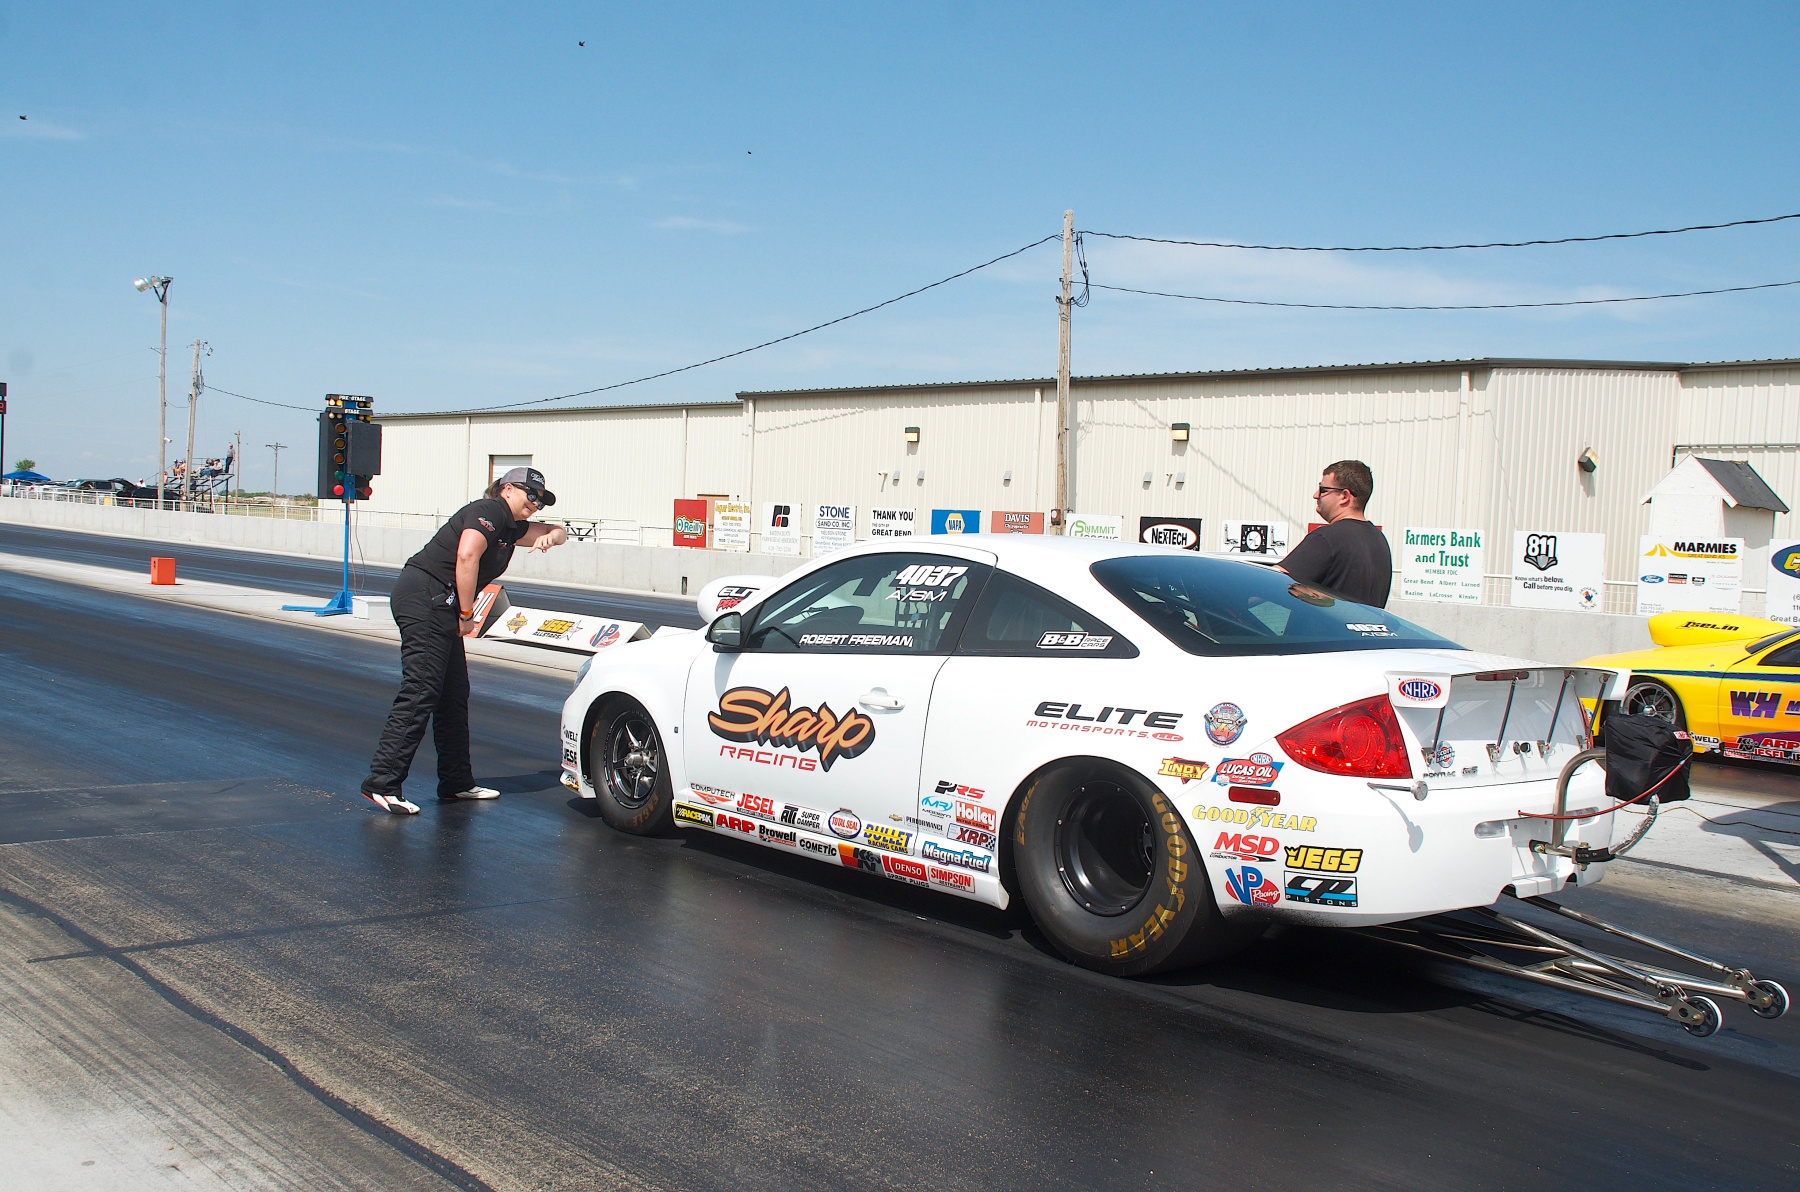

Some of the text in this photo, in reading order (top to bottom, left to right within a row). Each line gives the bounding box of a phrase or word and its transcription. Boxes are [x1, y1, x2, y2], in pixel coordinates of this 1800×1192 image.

[820, 506, 850, 518] STONE
[872, 510, 914, 521] THANK YOU
[1004, 514, 1030, 523] DAVIS
[676, 517, 704, 535] O'Reilly
[818, 520, 831, 528] SAND
[948, 520, 962, 530] NAPA
[1075, 520, 1116, 534] SUMMIT
[1406, 530, 1481, 548] Farmers Bank
[1527, 534, 1557, 558] 811
[1674, 542, 1737, 554] MARMIES
[1415, 550, 1470, 567] and Trust
[896, 565, 969, 586] 4037
[885, 588, 946, 602] A/SM
[1770, 614, 1791, 622] Great
[540, 619, 575, 633] JEGS
[591, 624, 619, 647] VP
[799, 634, 849, 645] ROBERT
[1041, 634, 1084, 645] B&B
[1405, 682, 1435, 697] NHRA
[1034, 701, 1184, 730] ELITE
[708, 686, 876, 772] Sharp
[1155, 734, 1180, 742] LLC
[1694, 736, 1719, 744] WELD
[1762, 739, 1800, 749] ARP
[720, 745, 817, 772] RACING
[1252, 754, 1270, 764] NHRA
[1158, 758, 1210, 780] INDY
[1220, 764, 1273, 778] LUCAS OIL
[690, 782, 736, 799] COMPUTECH
[737, 793, 775, 815] JESEL
[682, 808, 712, 825] RACEPAK
[780, 805, 798, 825] ATI
[801, 811, 820, 821] SUPER
[956, 800, 996, 830] Holley
[716, 814, 756, 834] ARP
[797, 818, 820, 830] DAMPER
[832, 816, 846, 828] TOTAL
[846, 819, 858, 831] SEAL
[906, 816, 944, 831] PERFORMANCE
[759, 825, 796, 842] Browell
[863, 823, 913, 847] BULLET
[956, 828, 989, 845] XRP
[799, 838, 837, 856] COMETIC
[867, 839, 909, 854] RACING CAMS
[1214, 832, 1280, 855] MSD
[853, 848, 881, 872] K&N
[923, 841, 992, 873] MagnaFuel
[1286, 846, 1364, 874] JEGS
[895, 863, 922, 876] DENSO
[930, 867, 971, 887] SIMPSON
[887, 873, 930, 888] SPARK PLUGS
[939, 880, 966, 890] RESTRAINTS
[1225, 866, 1263, 906] VP
[1253, 887, 1280, 902] Racing
[1286, 894, 1358, 907] PISTONS
